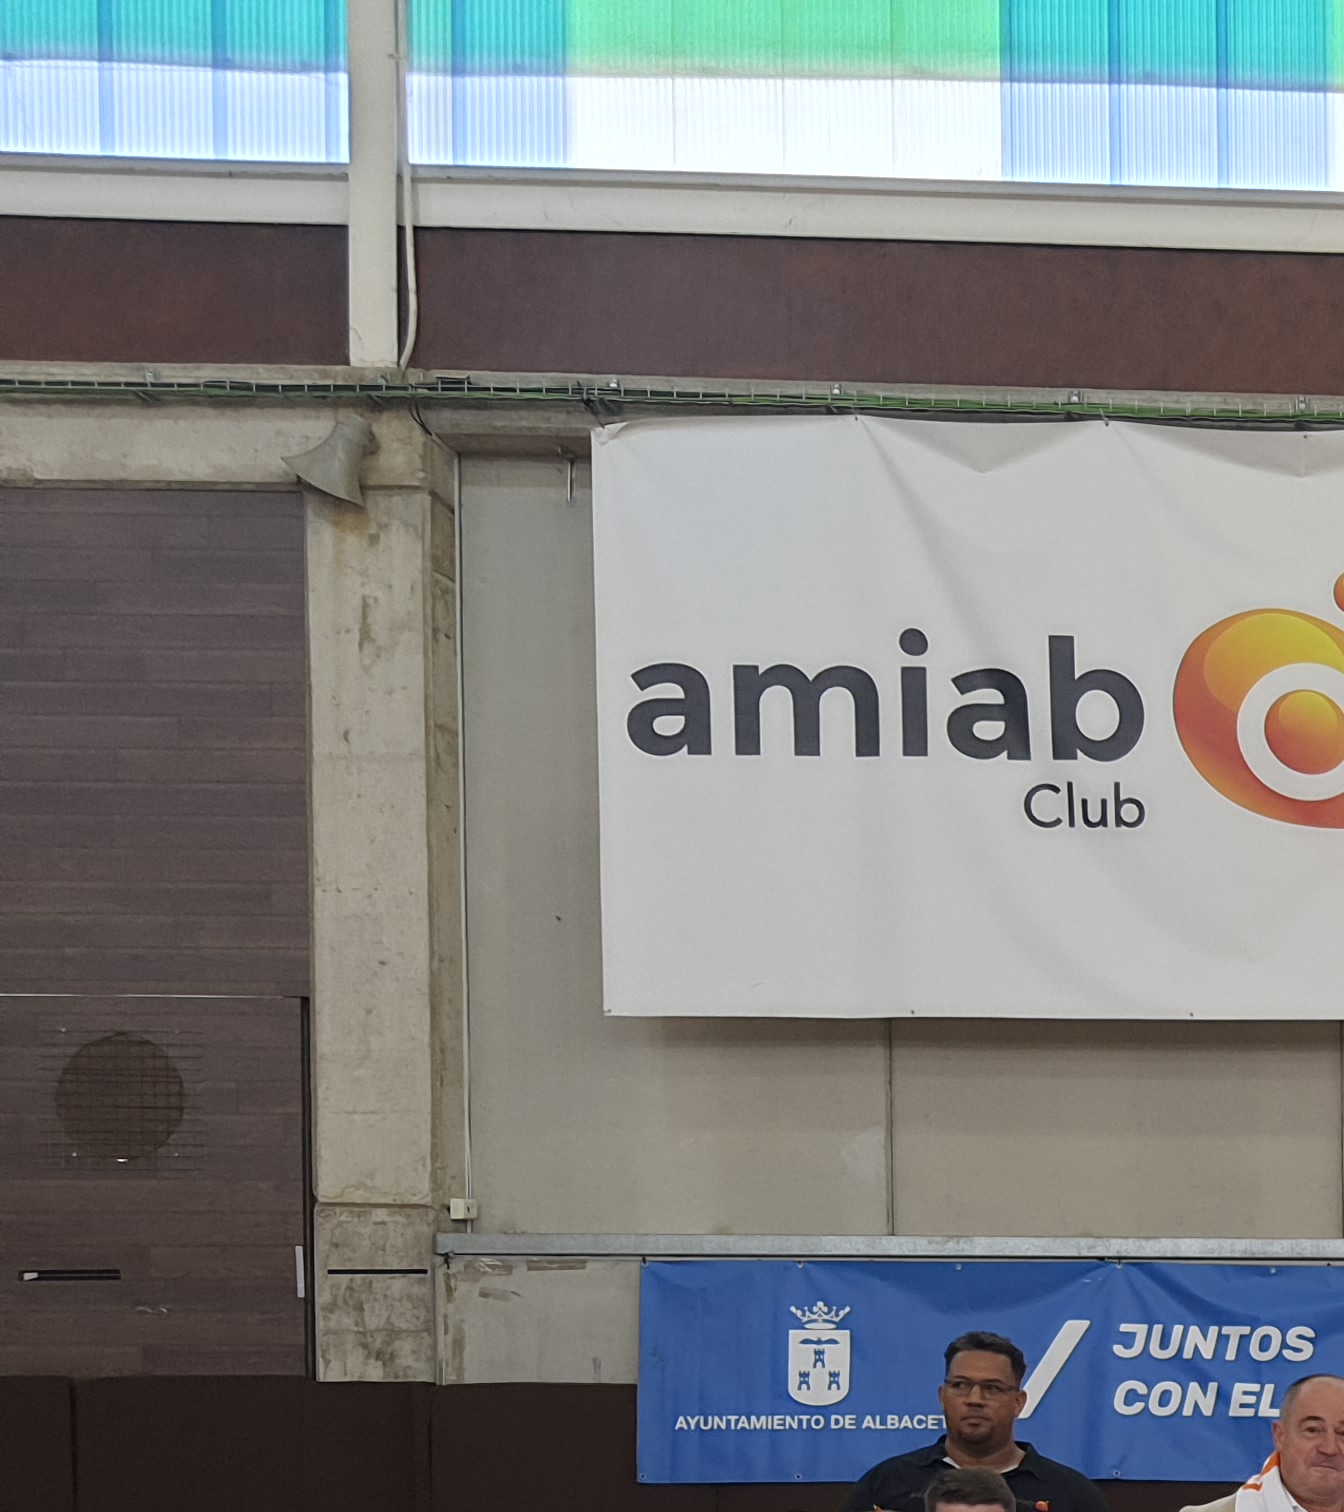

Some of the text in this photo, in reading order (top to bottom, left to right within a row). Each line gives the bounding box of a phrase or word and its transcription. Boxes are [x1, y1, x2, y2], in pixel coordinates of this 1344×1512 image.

[627, 628, 1146, 762] amiab
[1023, 782, 1146, 829] Club
[1112, 1323, 1316, 1362] JUNTOS
[1113, 1380, 1218, 1417] CON
[1229, 1383, 1281, 1418] EL
[674, 1414, 947, 1431] AYUNTAMIENTO DE ALBACET
